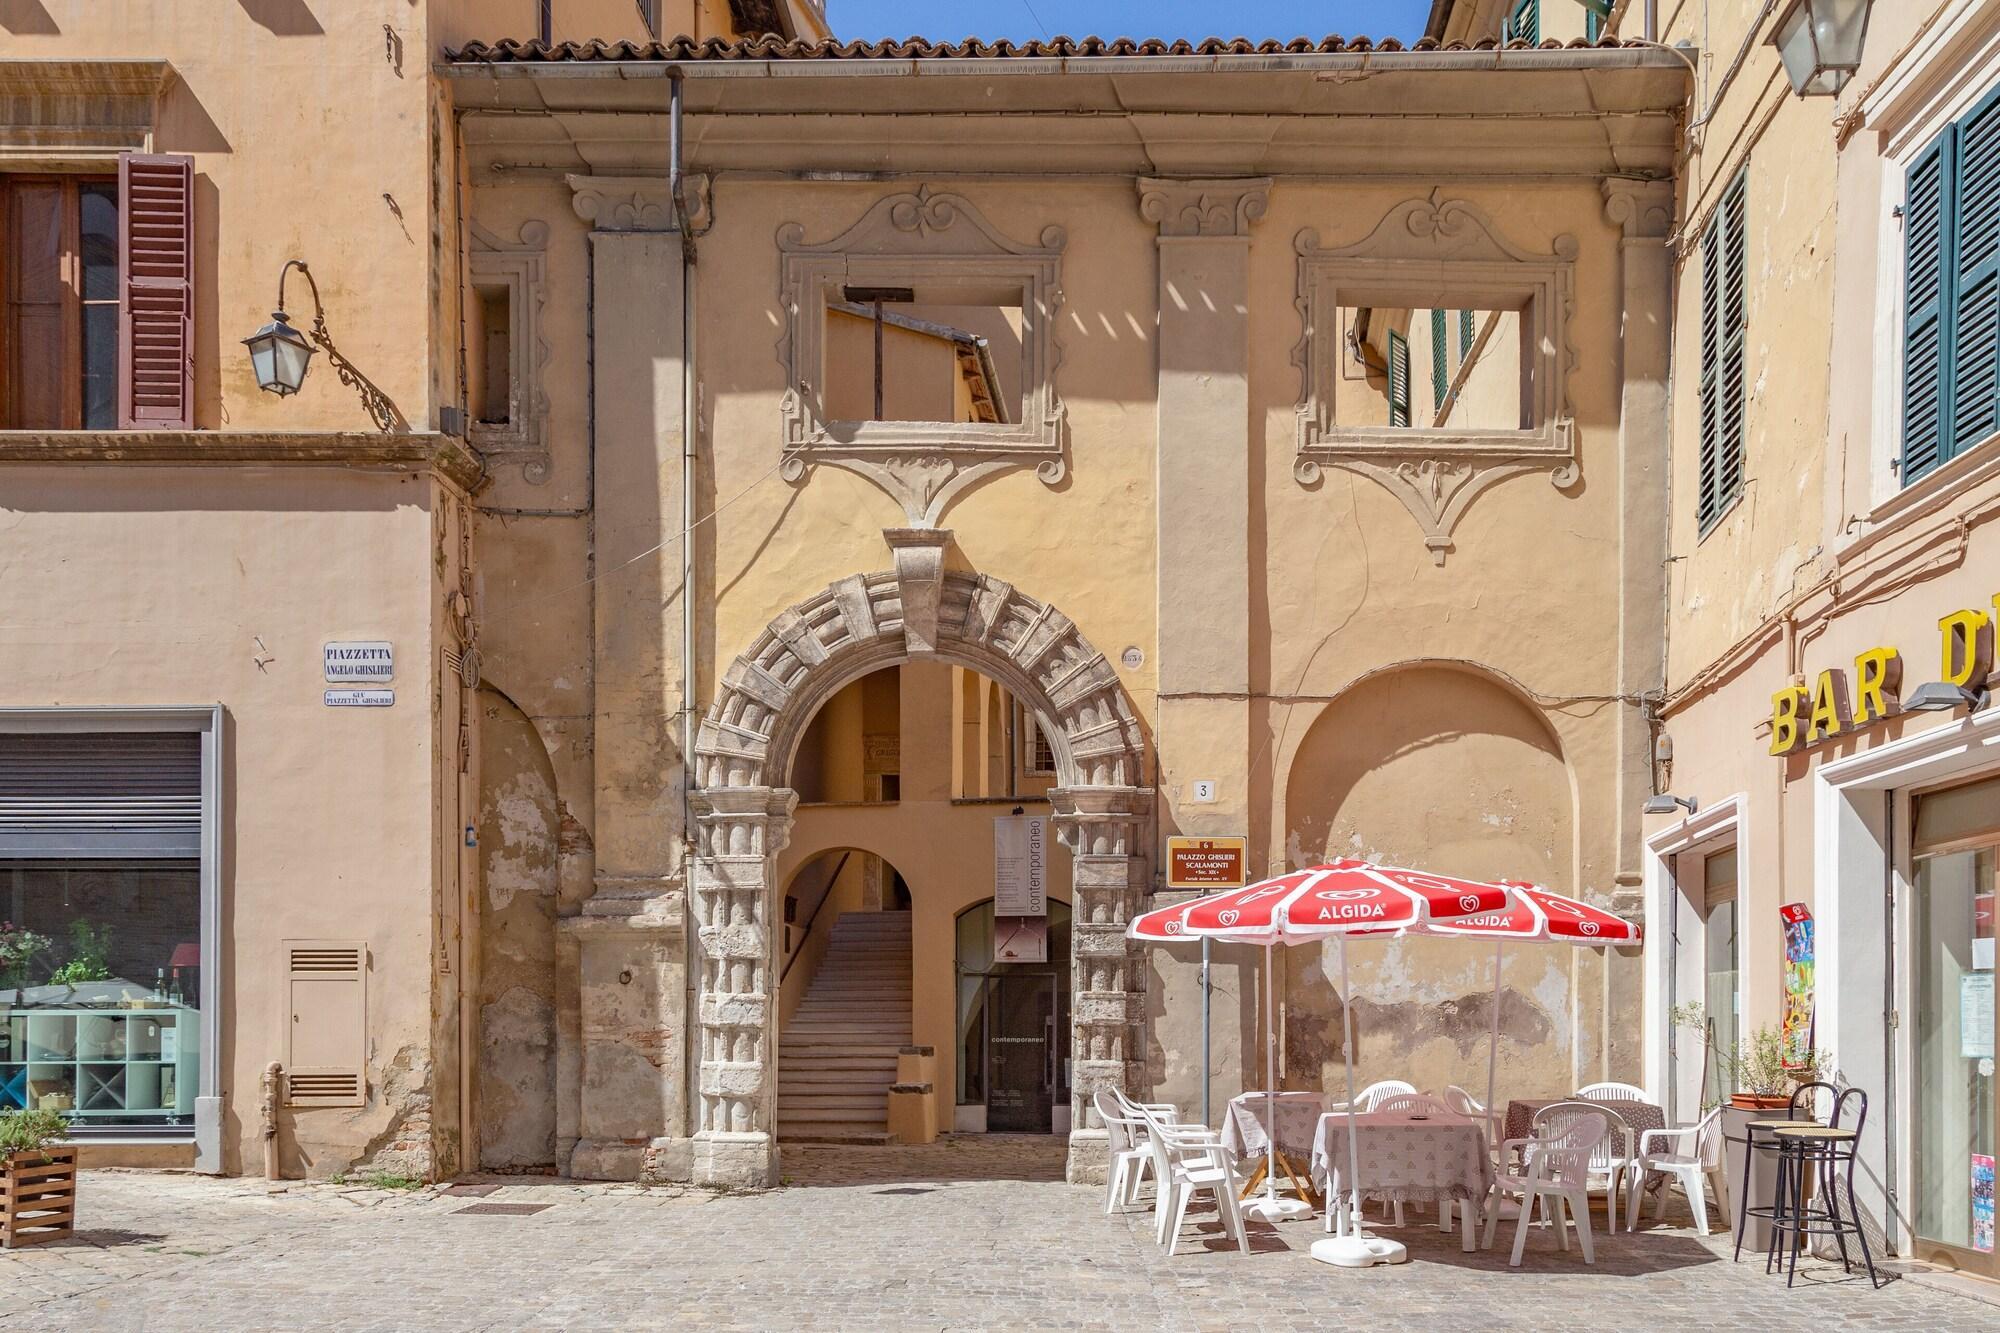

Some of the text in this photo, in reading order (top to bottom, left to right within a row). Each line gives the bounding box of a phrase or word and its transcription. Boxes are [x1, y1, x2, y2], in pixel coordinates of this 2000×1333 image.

[326, 648, 391, 660] PIAZZETTA
[326, 664, 392, 675] ANGELO GHISLIERI
[1769, 592, 2000, 756] BAR D
[1200, 785, 1207, 797] 3
[1203, 841, 1209, 849] 6
[1176, 853, 1236, 861] PALAZZO GHISLIERI
[1030, 820, 1044, 913] contemporaneo
[1318, 903, 1385, 920] ALGIDA
